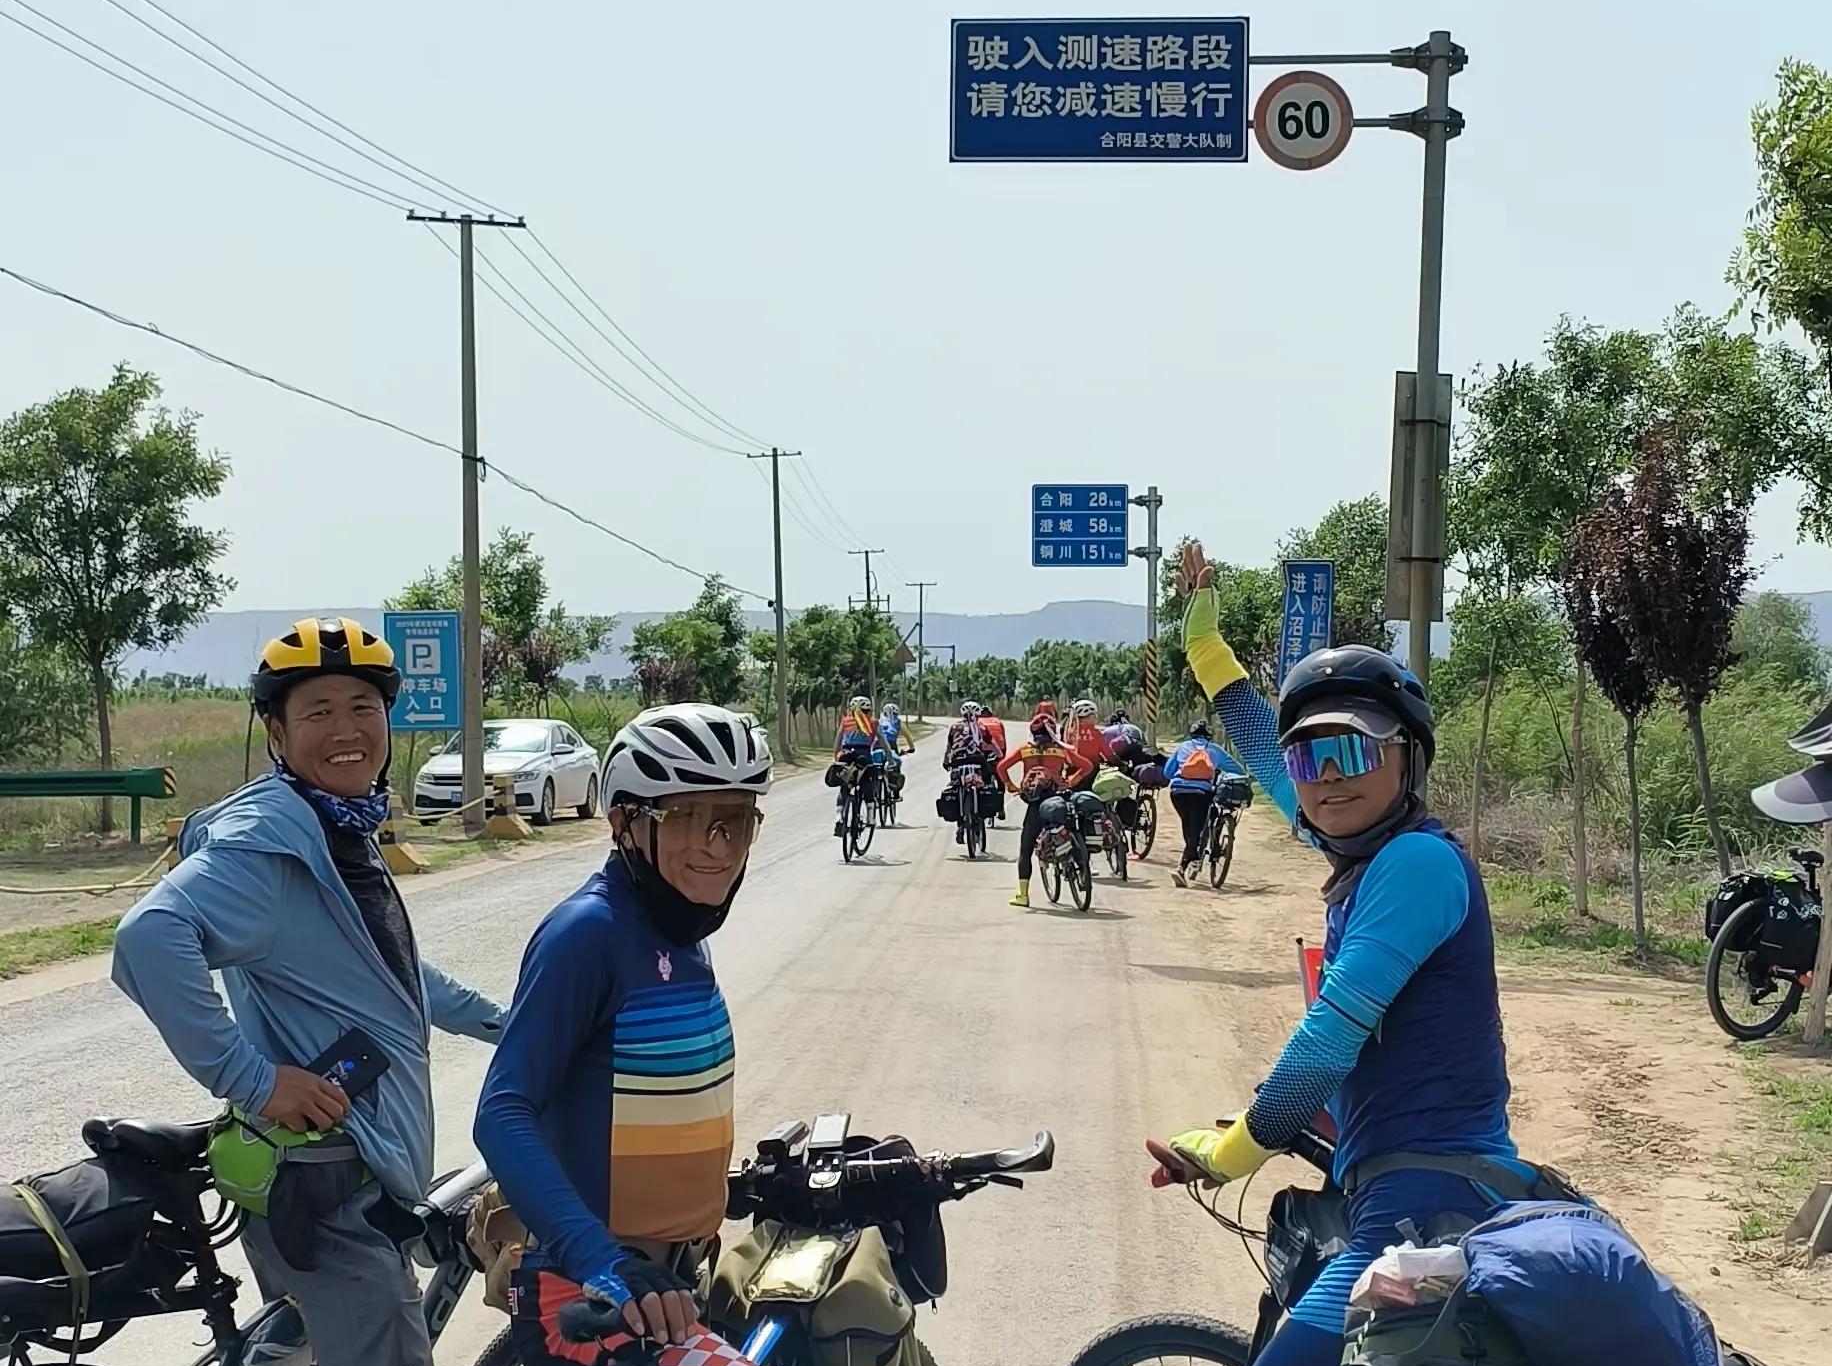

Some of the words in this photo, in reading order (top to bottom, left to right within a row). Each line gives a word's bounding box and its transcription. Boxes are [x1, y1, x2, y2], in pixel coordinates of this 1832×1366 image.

[967, 34, 1232, 71] 驶入测速路段
[967, 81, 1233, 118] 请您减速慢行
[1277, 100, 1330, 141] 60
[1100, 132, 1232, 149] 合阳县交警大队制
[1040, 491, 1073, 507] 合阳
[1308, 573, 1328, 649] 请防止
[412, 644, 431, 668] P
[401, 677, 447, 693] 停车场
[406, 695, 442, 709] 入口
